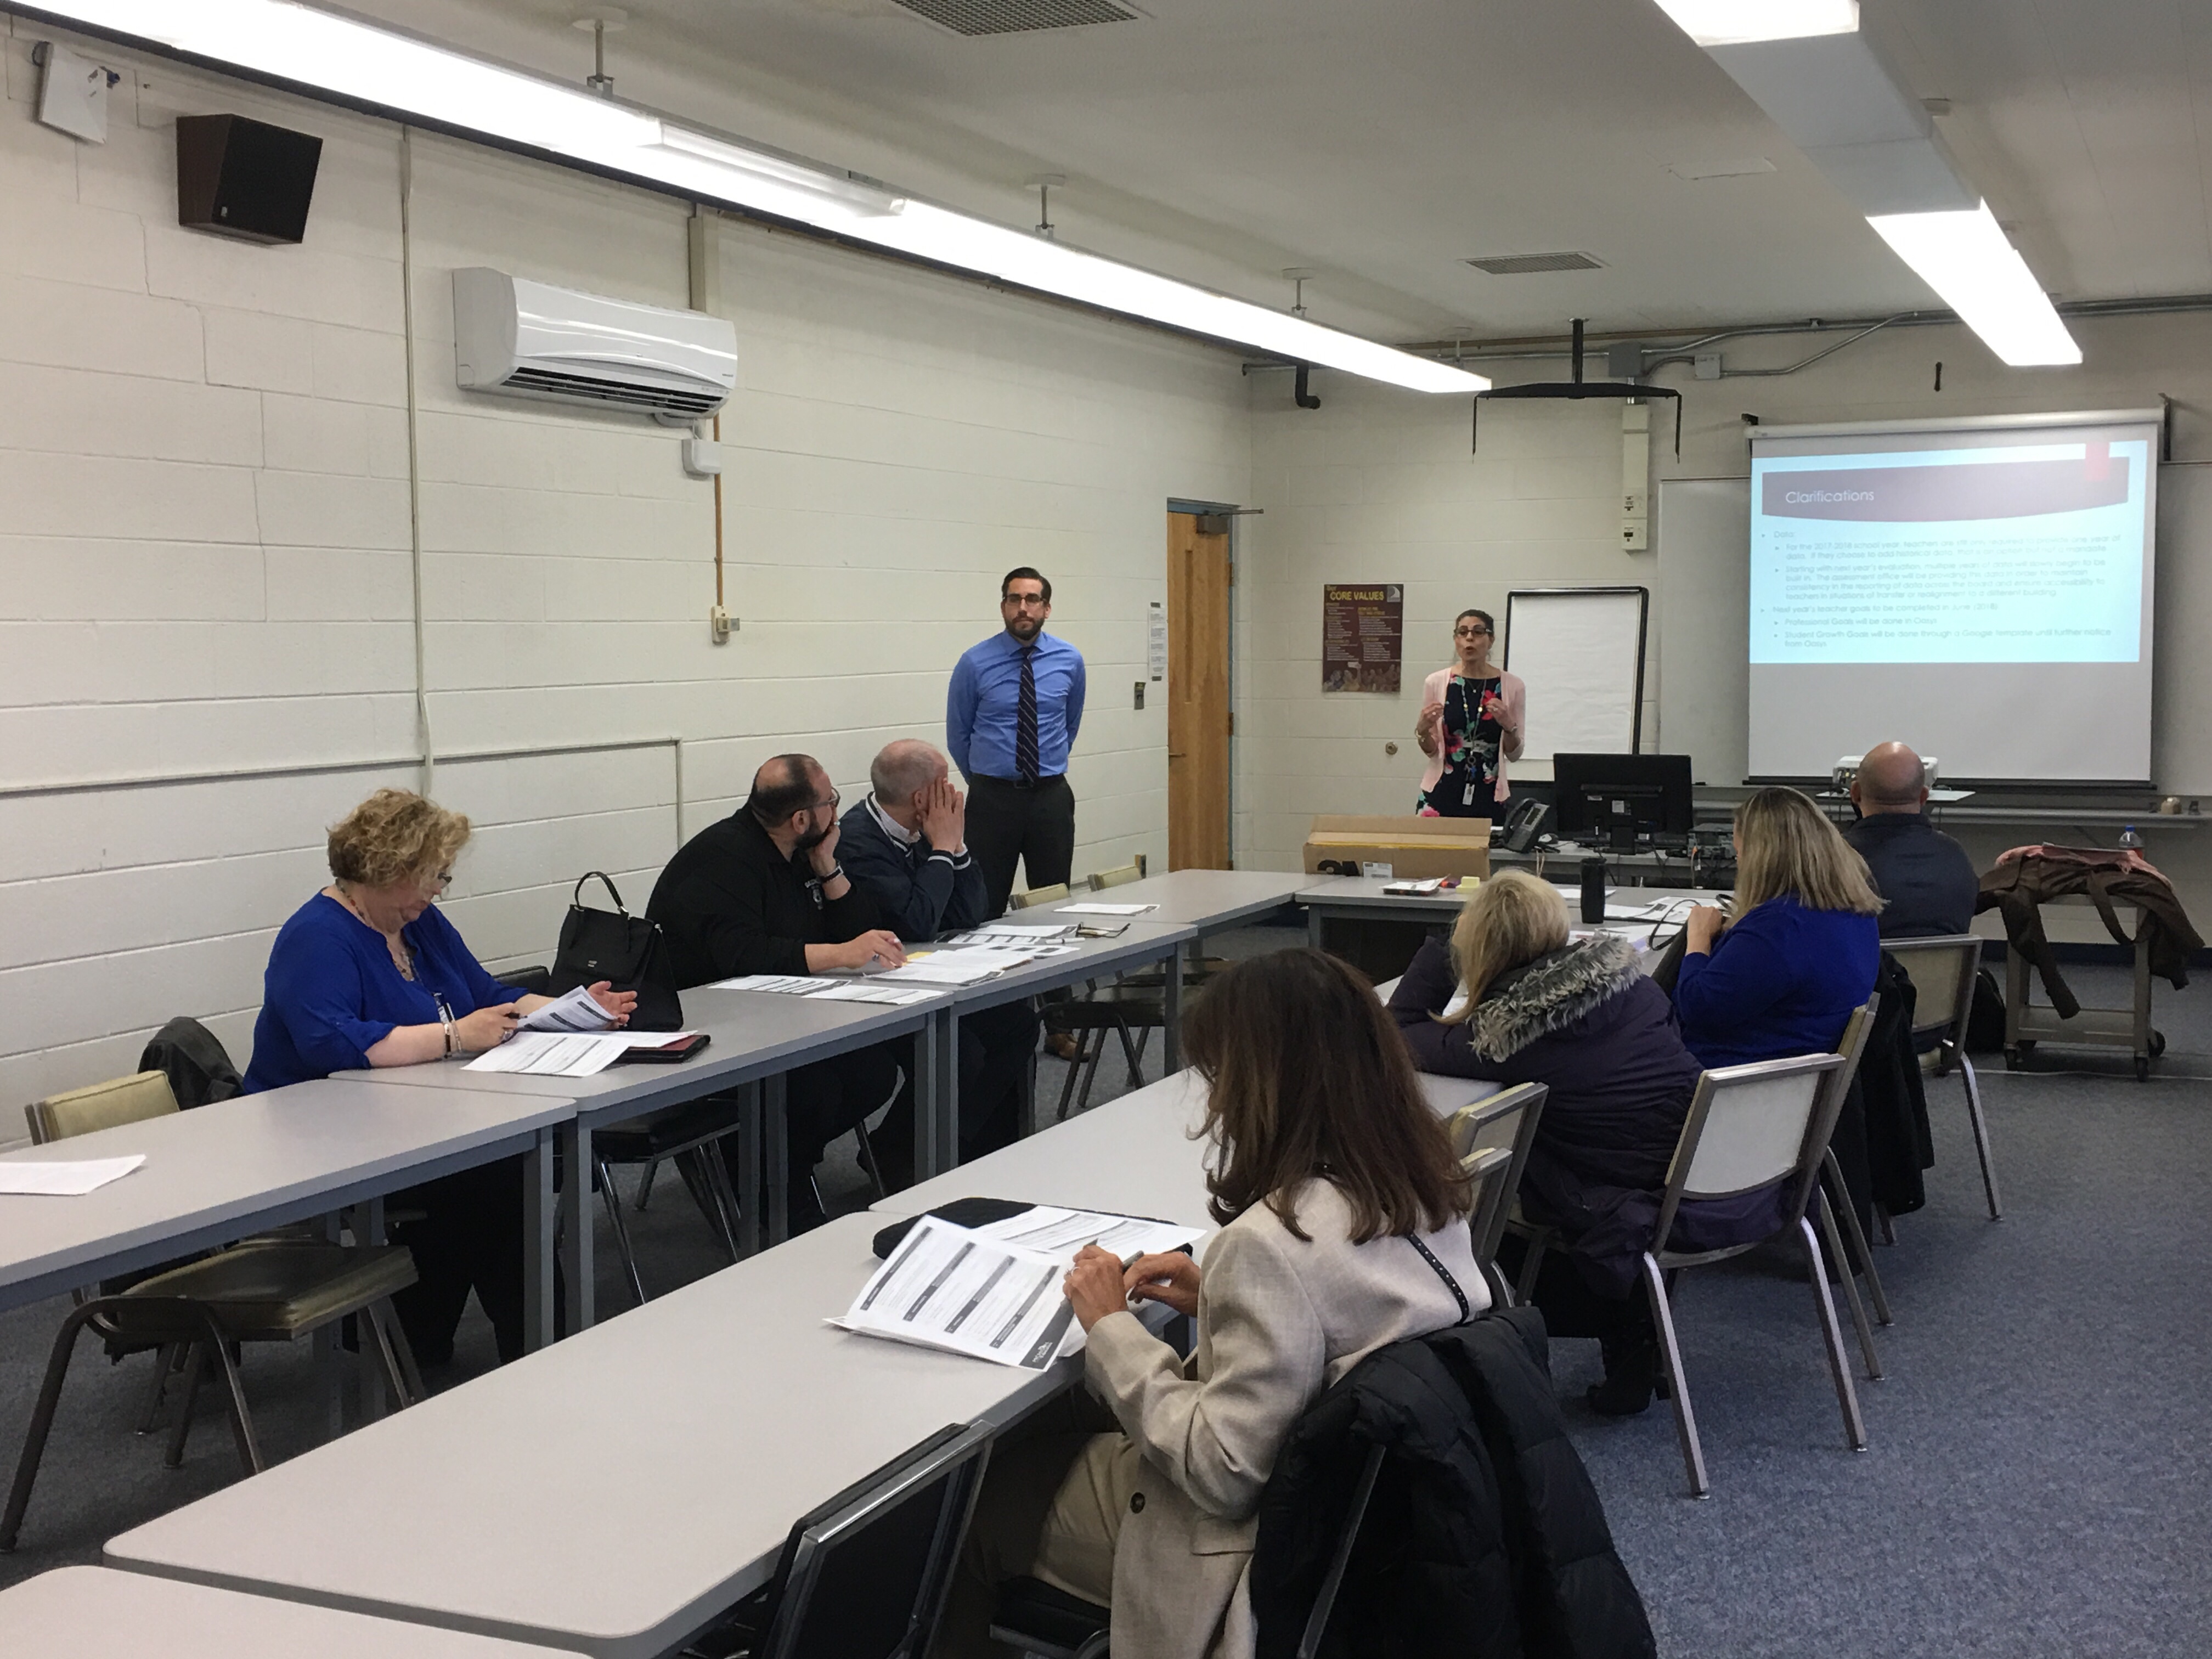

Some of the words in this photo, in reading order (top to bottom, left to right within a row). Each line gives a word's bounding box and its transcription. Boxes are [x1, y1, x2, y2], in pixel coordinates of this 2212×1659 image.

[1785, 489, 1875, 503] Clarifications
[1818, 552, 1835, 560] they
[1786, 565, 1815, 573] Starting
[1928, 572, 1966, 580] providing
[1855, 583, 1891, 591] reporting
[2044, 578, 2094, 586] accessibility
[1329, 591, 1352, 601] CORE
[1353, 591, 1384, 601] VALUES
[1917, 590, 1965, 599] realignment
[1962, 629, 1993, 638] Google
